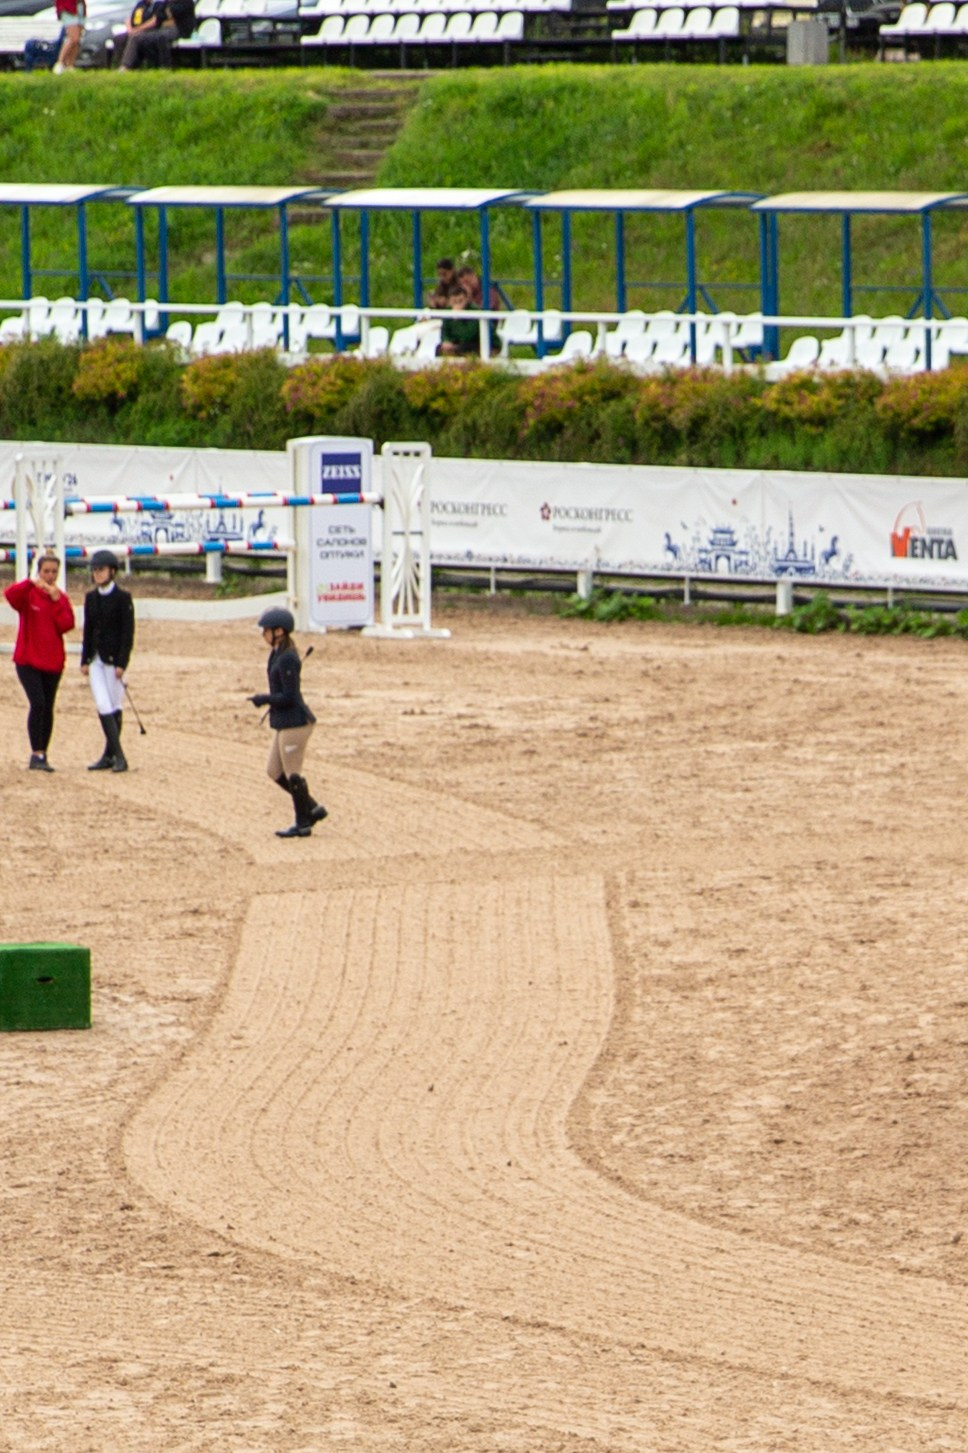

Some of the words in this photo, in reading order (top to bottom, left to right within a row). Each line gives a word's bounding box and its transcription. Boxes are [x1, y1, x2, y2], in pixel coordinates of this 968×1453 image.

[322, 464, 361, 480] ZEISS
[431, 500, 507, 517] РОСКОНГРЕСС
[553, 506, 634, 522] РОСКОНГРЕСС
[890, 527, 958, 560] VENTA
